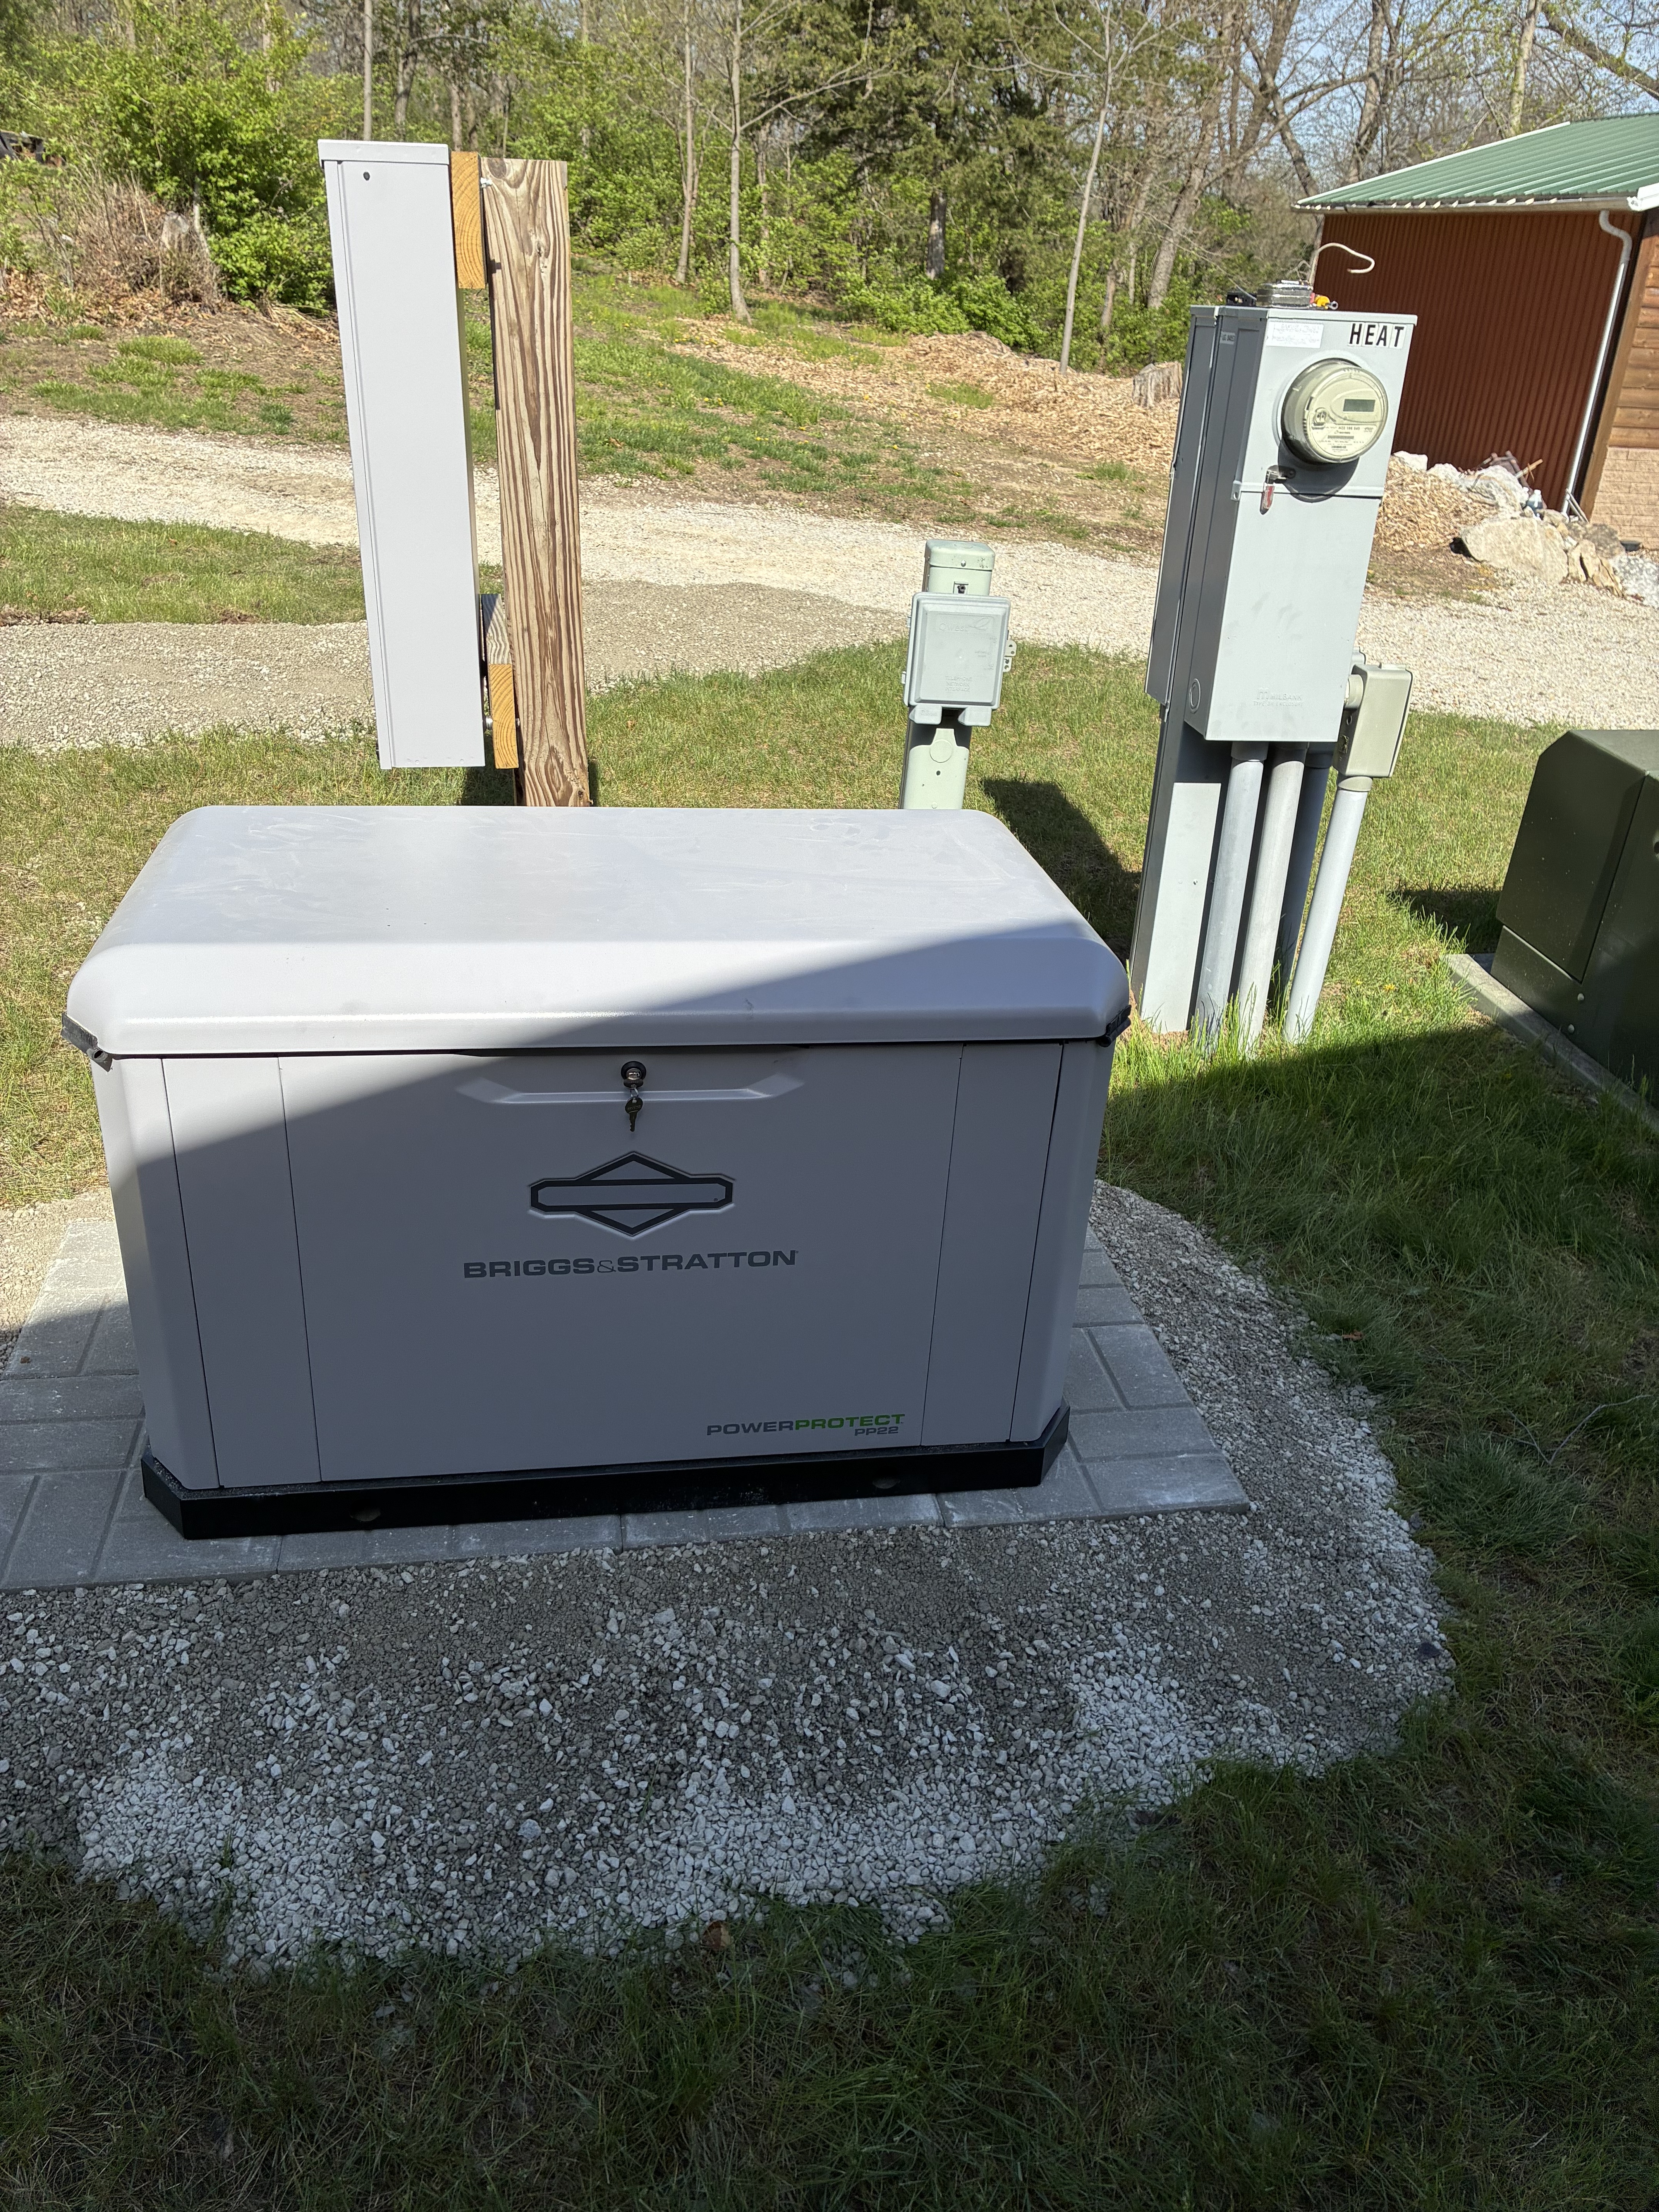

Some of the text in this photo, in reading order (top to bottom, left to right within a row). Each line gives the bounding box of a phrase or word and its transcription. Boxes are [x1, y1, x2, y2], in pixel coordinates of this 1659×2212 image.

[1350, 324, 1404, 347] HEAT
[707, 1413, 905, 1436] POWERPROTECT
[854, 1426, 899, 1436] PP22
